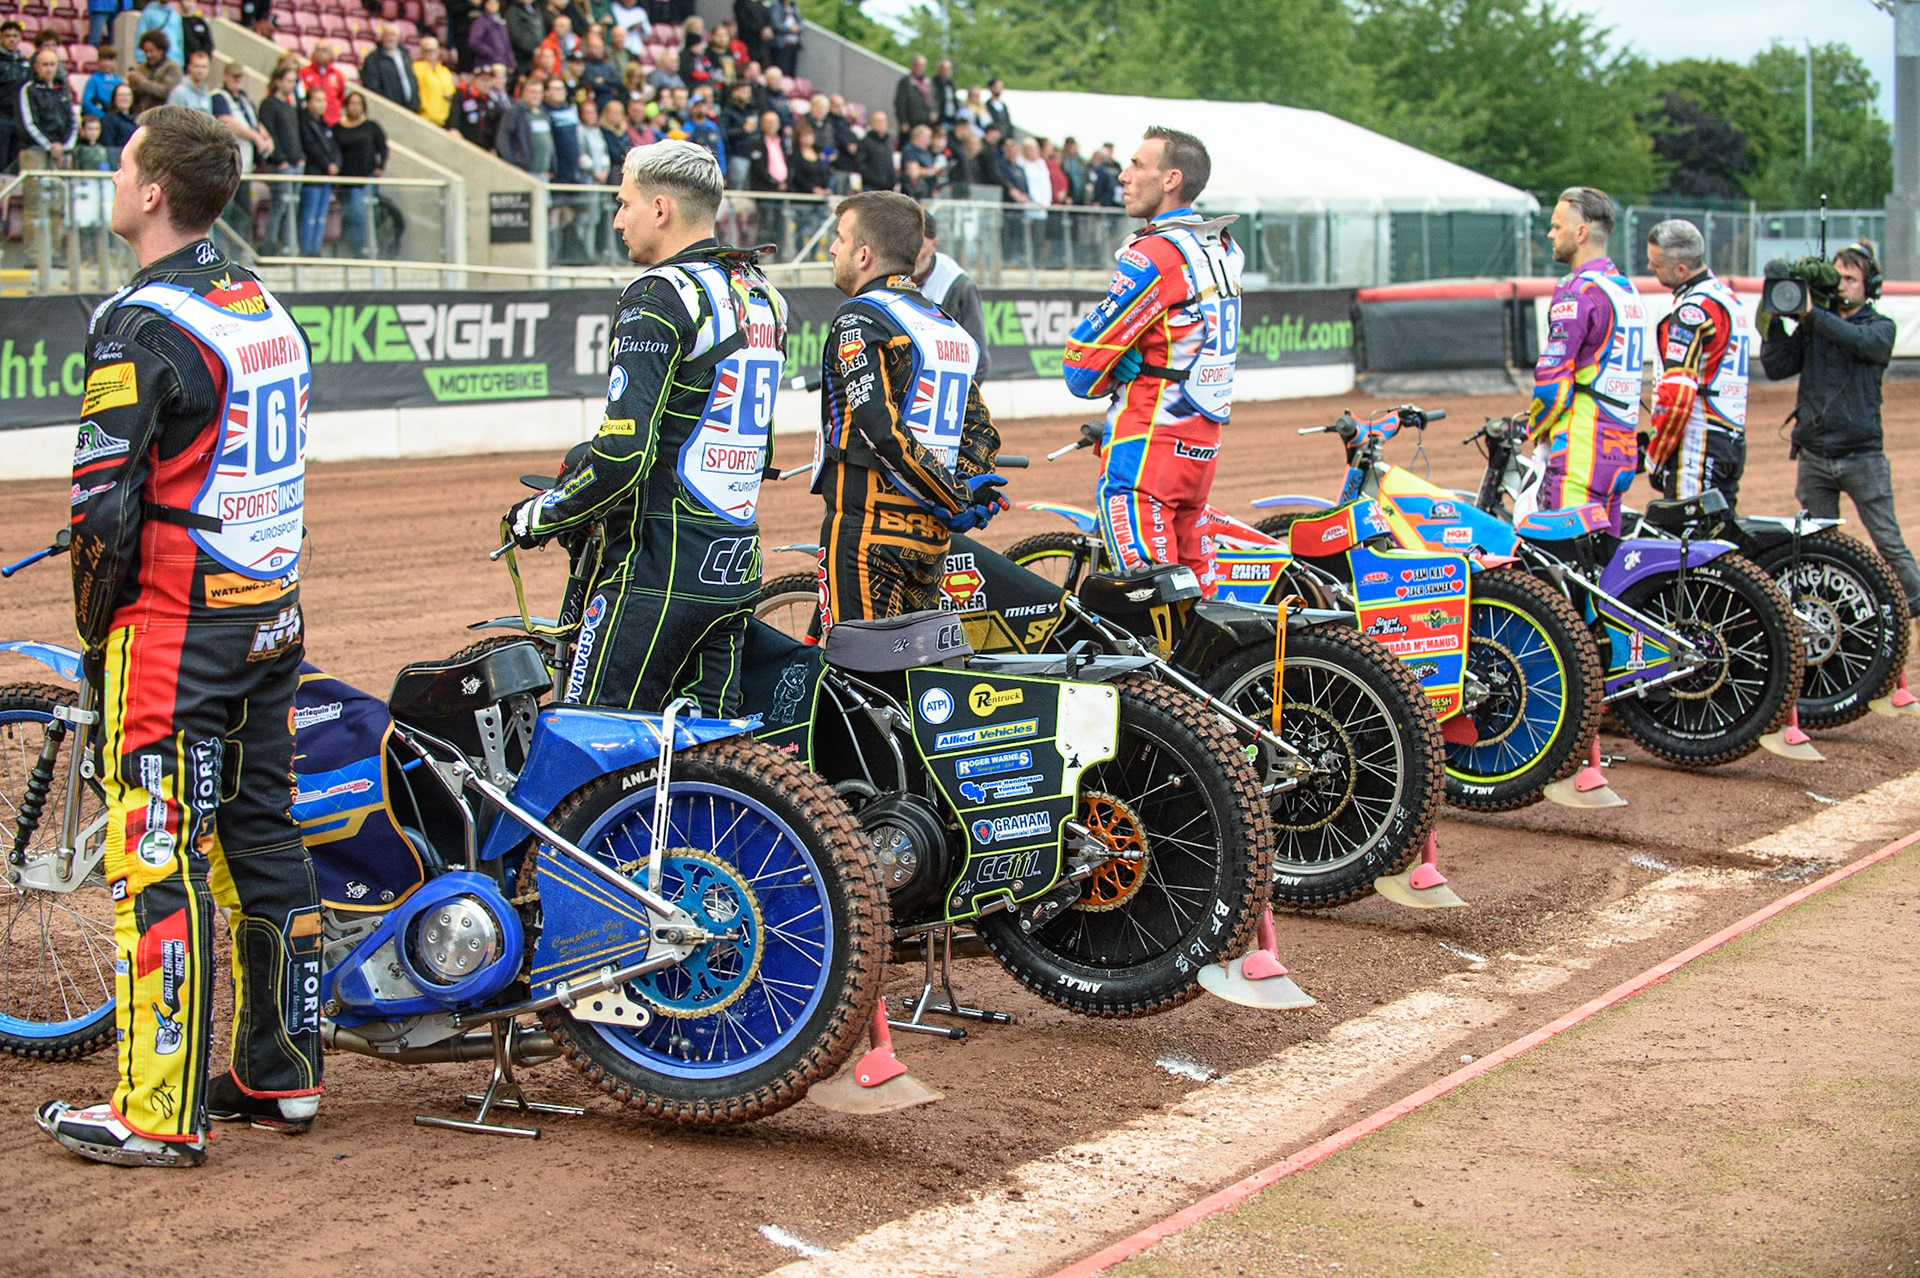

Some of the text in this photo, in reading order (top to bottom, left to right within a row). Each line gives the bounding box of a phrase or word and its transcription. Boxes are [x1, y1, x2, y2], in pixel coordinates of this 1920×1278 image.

[841, 330, 860, 344] SUE
[1225, 304, 1236, 350] 3
[236, 333, 301, 375] HOWARTH
[618, 335, 669, 354] Euston
[936, 339, 970, 364] BARKER
[1631, 330, 1641, 368] 2
[439, 370, 544, 396] MOTORBIKE
[754, 367, 772, 428] 5
[943, 378, 959, 430] 4
[267, 389, 289, 463] 6
[705, 447, 758, 471] SPORTS
[222, 488, 279, 522] SPORTS
[254, 518, 299, 543] EUROSPORT
[1446, 529, 1469, 538] NGK
[945, 555, 973, 572] SUE
[1231, 563, 1272, 573] MICK
[1692, 566, 1723, 578] ANLAS
[1230, 571, 1271, 580] SMITH
[1413, 569, 1428, 580] SAM
[211, 583, 260, 598] WATLING
[1004, 602, 1059, 618] MIKEY
[925, 699, 948, 713] ATPI
[973, 691, 1022, 709] Rentruck
[939, 723, 1033, 747] Allied Vehicles
[959, 751, 1030, 776] ROGER WARNES
[198, 748, 214, 810] FORT
[621, 768, 667, 791] ANLA
[1004, 775, 1043, 785] Henderson
[1462, 784, 1494, 796] ANLAS
[994, 812, 1050, 832] GRAHAM
[1272, 873, 1302, 887] ANLA
[551, 928, 599, 949] Complete
[603, 931, 624, 945] Ltd
[175, 941, 184, 977] RACING
[303, 961, 319, 1026] FORT
[1056, 973, 1102, 994] ANLAS
